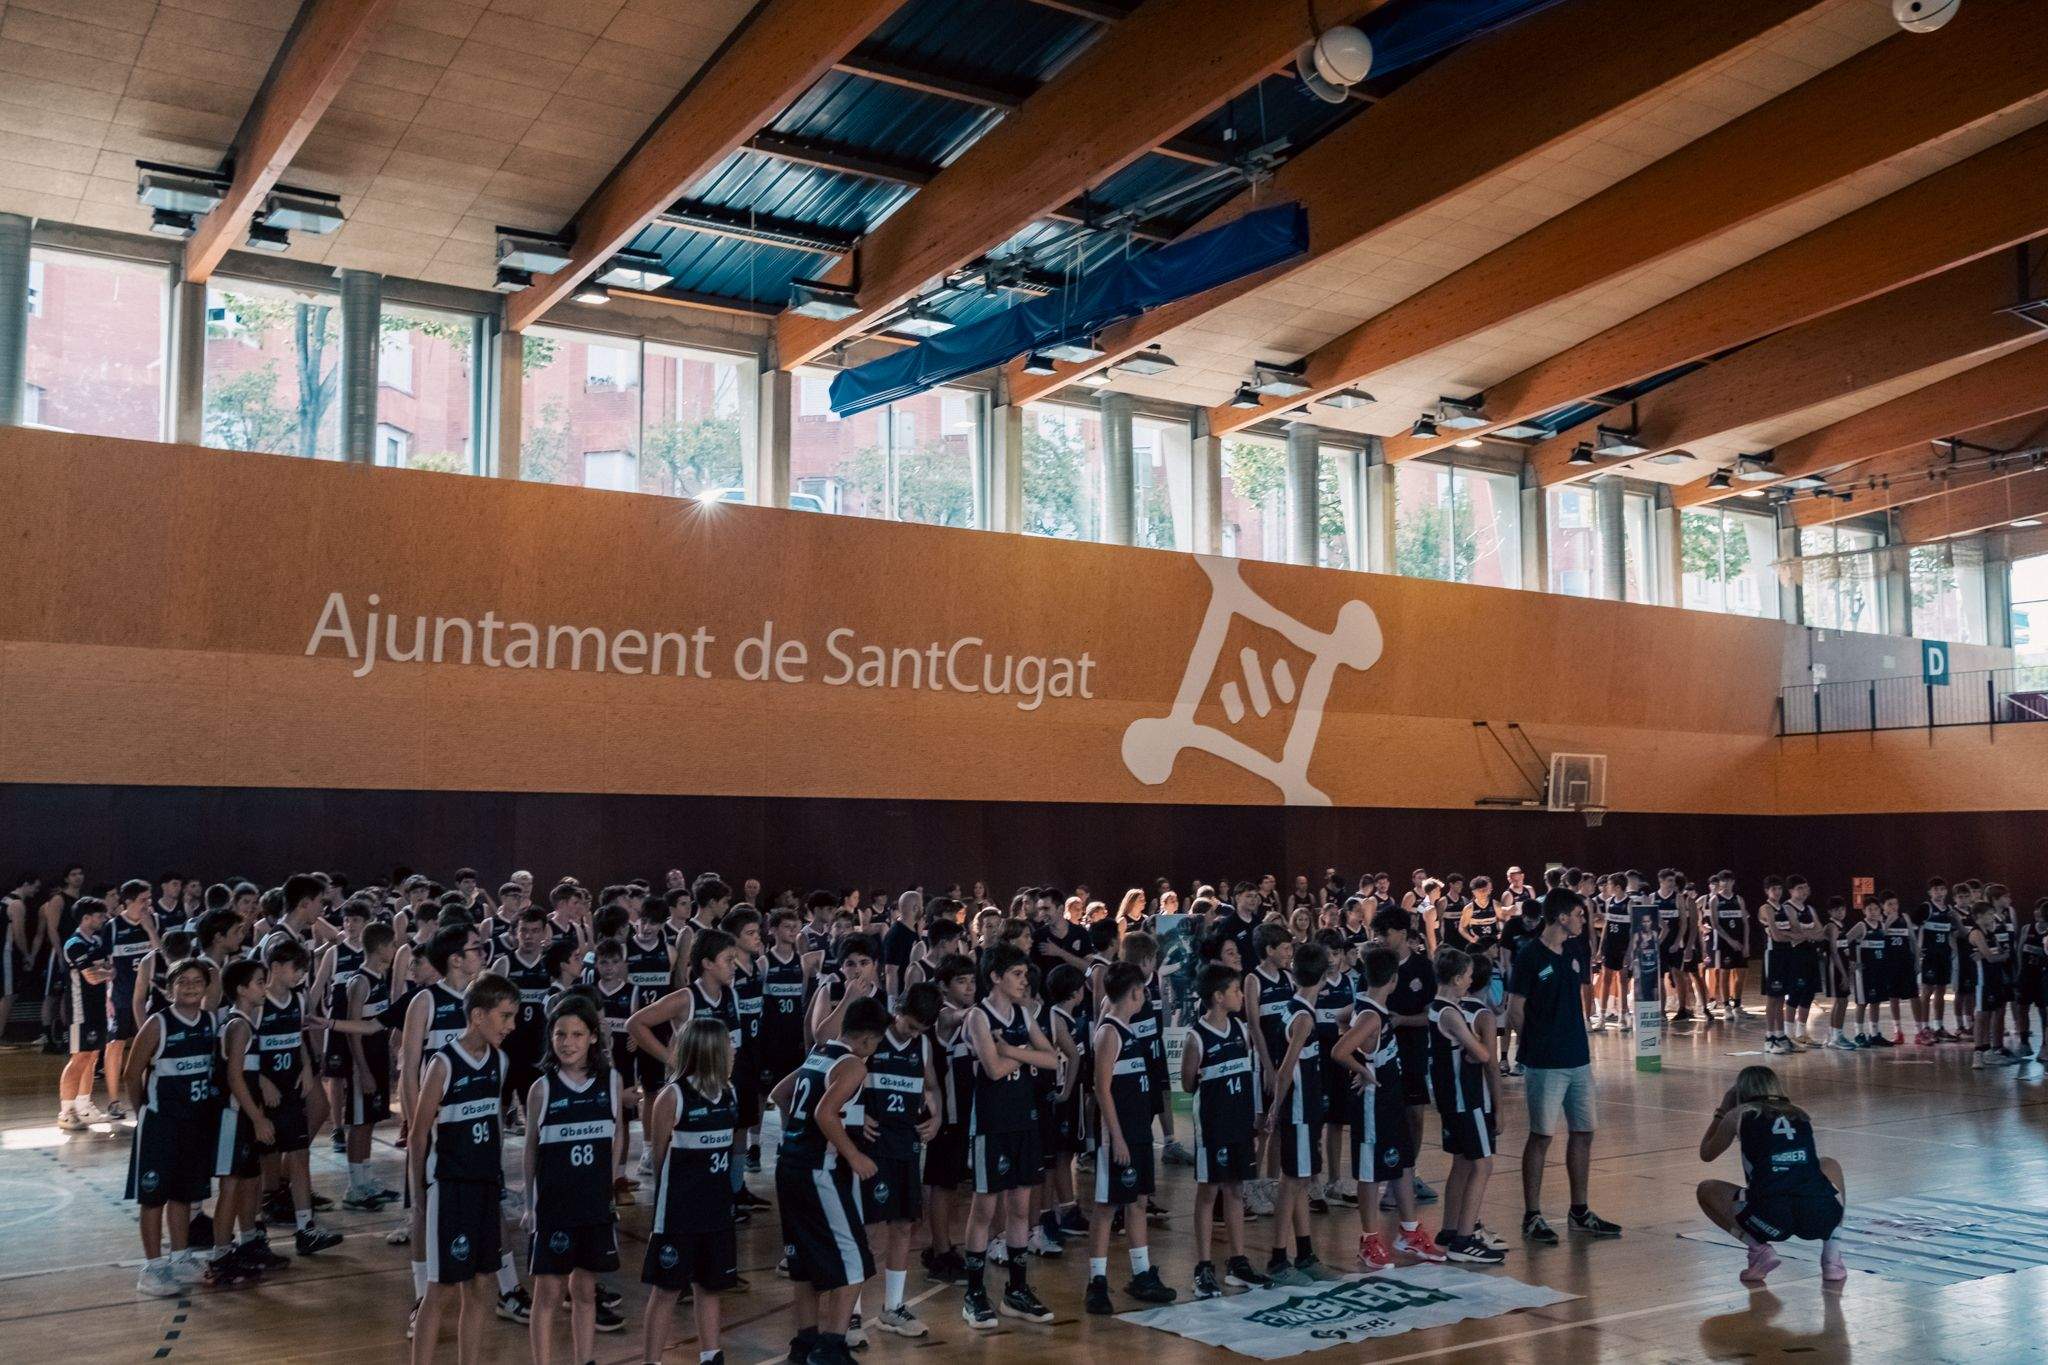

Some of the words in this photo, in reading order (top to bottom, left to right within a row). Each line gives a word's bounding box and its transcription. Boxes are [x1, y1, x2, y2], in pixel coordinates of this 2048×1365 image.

[305, 591, 715, 678] Ajuntament
[733, 620, 808, 684] de
[822, 626, 1097, 711] SantCugat
[1928, 647, 1944, 676] D
[779, 999, 793, 1014] 30
[176, 1059, 209, 1072] Qbask
[272, 1052, 292, 1072] 30
[880, 1077, 914, 1089] Qbasket
[1226, 1076, 1242, 1095] 14
[559, 1124, 605, 1138] Qbasket
[1771, 1115, 1797, 1141] 4
[700, 1133, 732, 1145] Qbask
[570, 1143, 595, 1167] 68
[709, 1150, 729, 1174] 34
